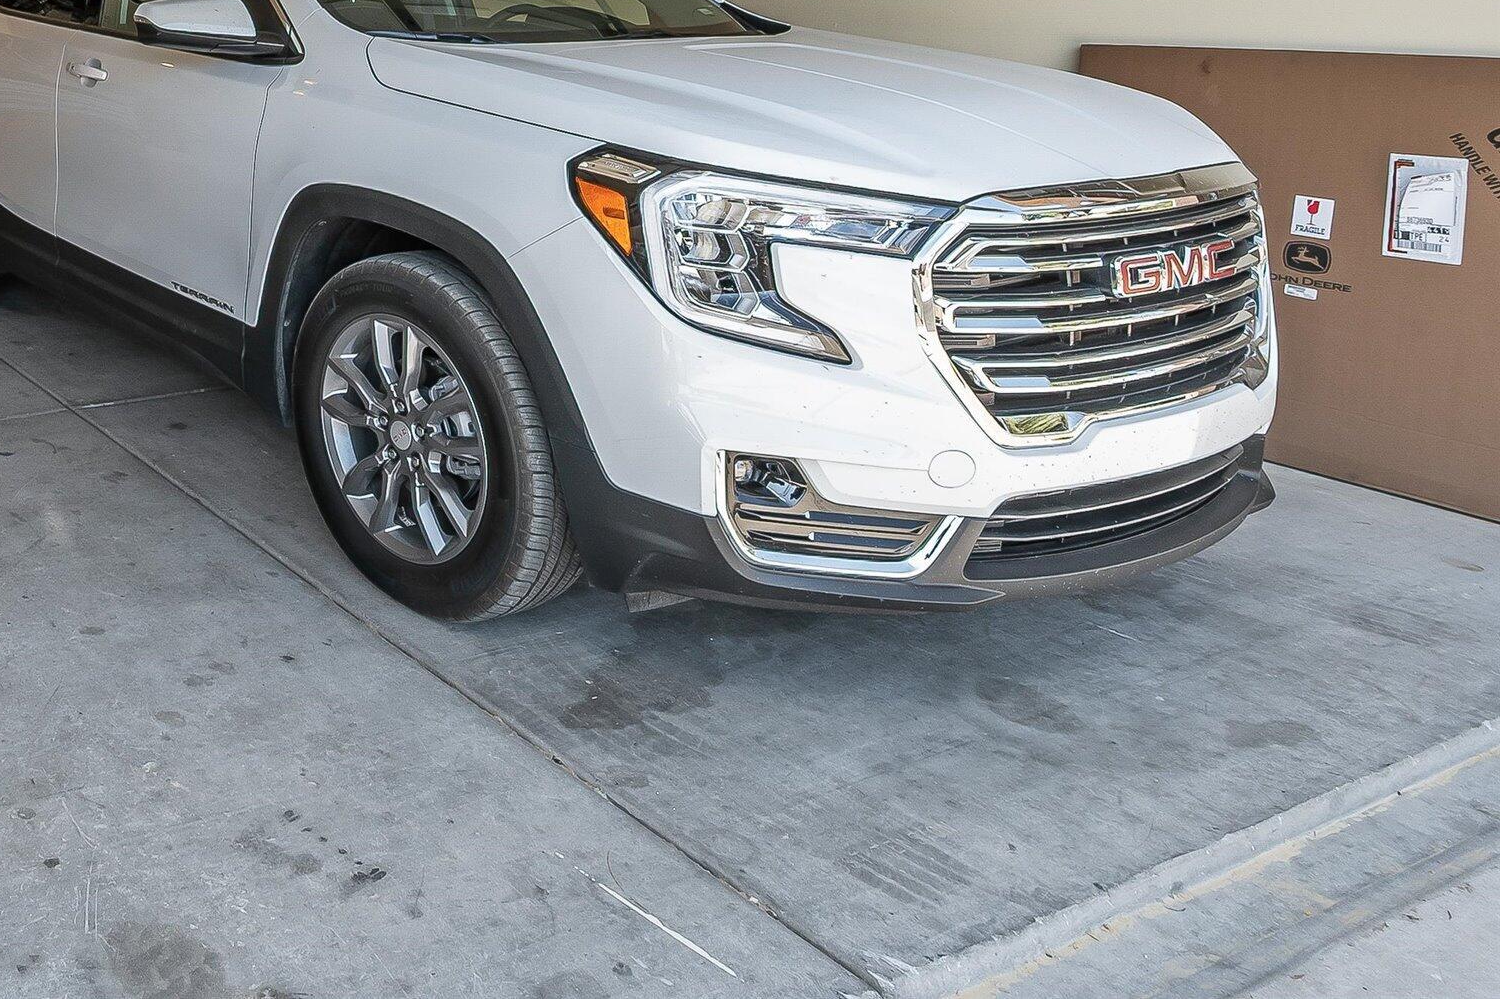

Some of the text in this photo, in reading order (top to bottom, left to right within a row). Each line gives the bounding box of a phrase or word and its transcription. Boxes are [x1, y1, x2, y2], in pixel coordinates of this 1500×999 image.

[1449, 132, 1491, 175] HANDLE
[1294, 223, 1327, 236] FRAGILE
[1114, 238, 1236, 298] GMC
[1270, 272, 1297, 285] OHN
[1301, 277, 1352, 292] DEERE
[170, 280, 236, 314] TERRAIN
